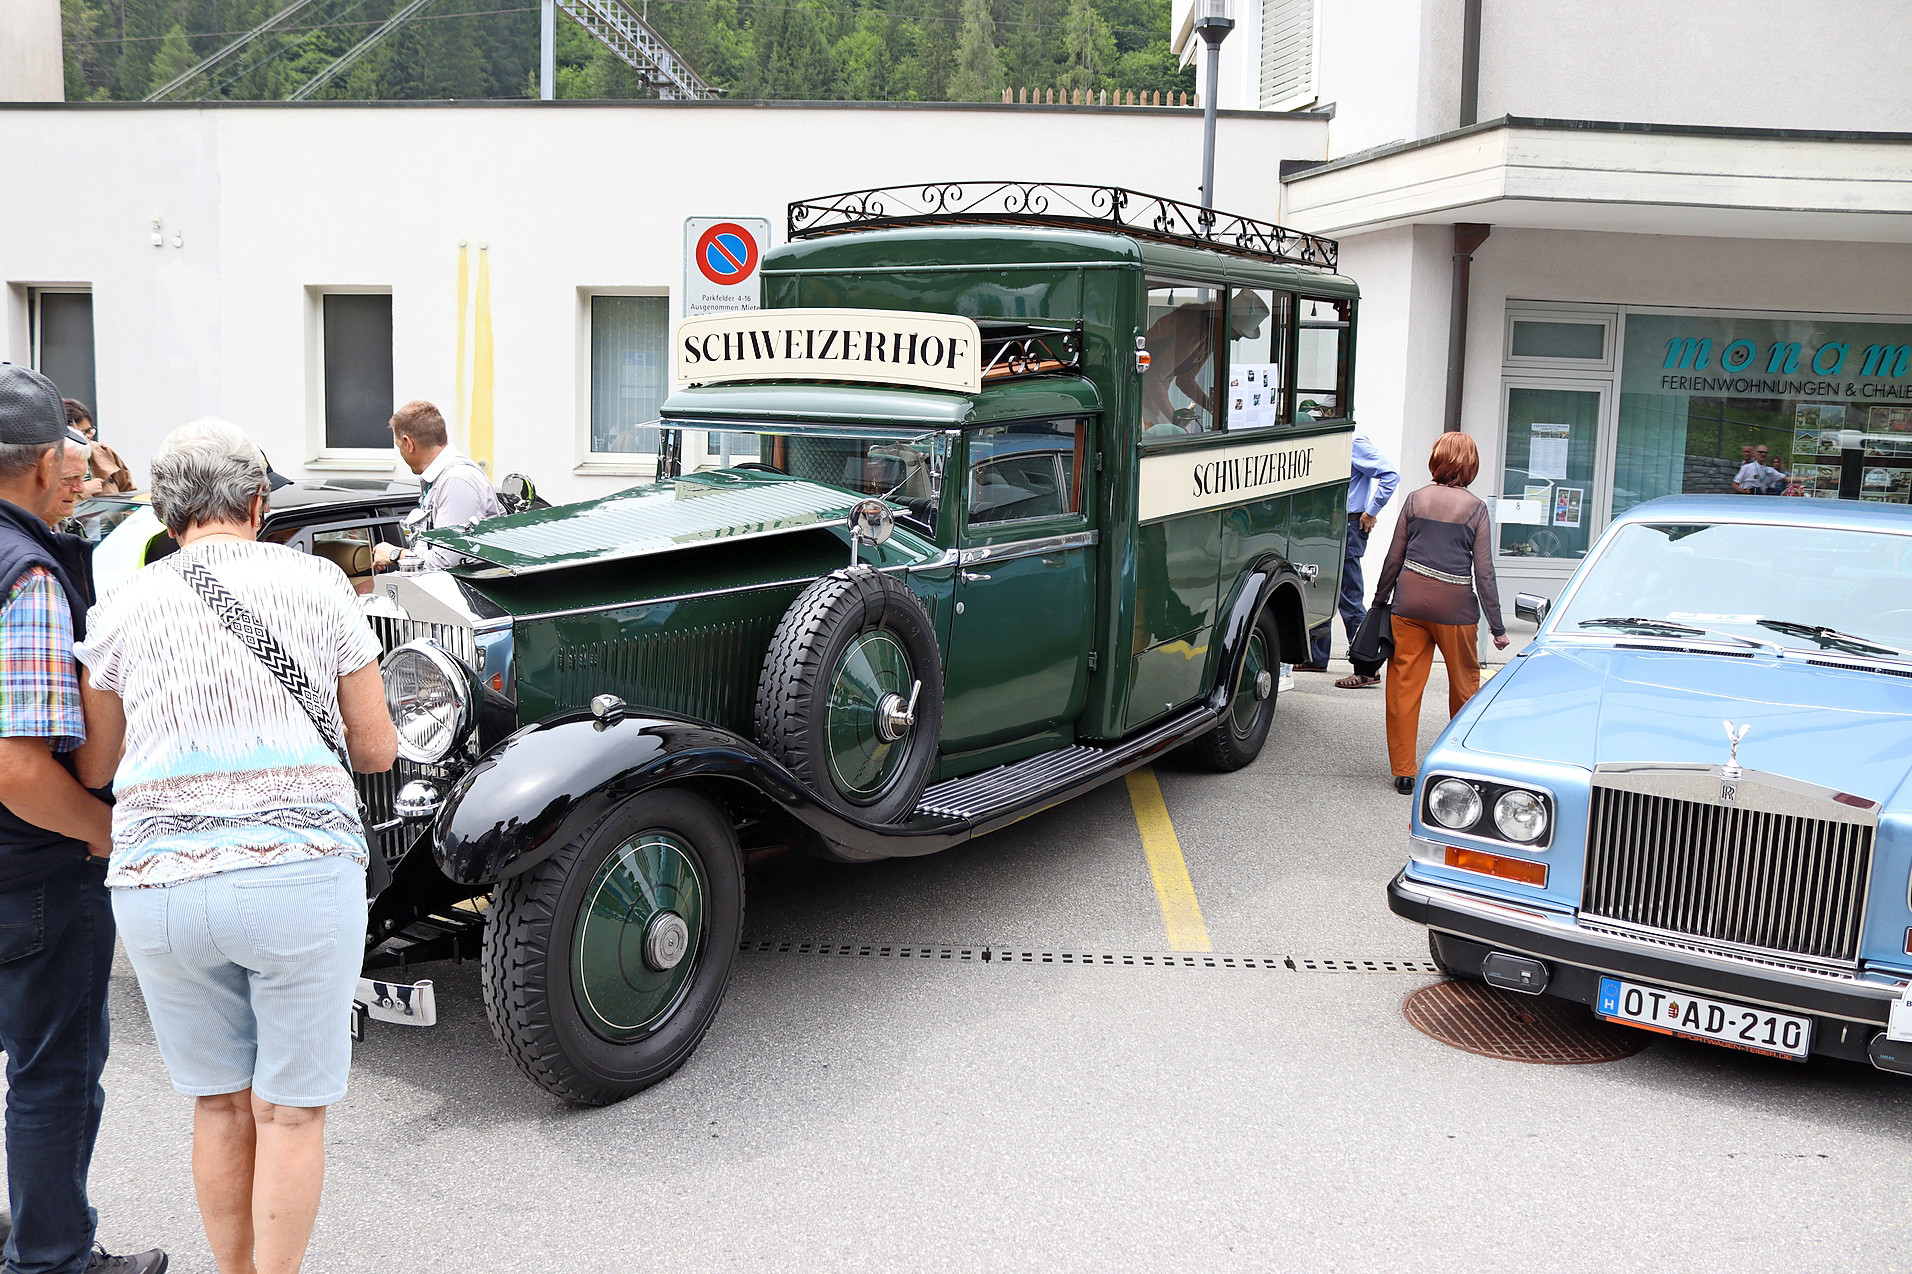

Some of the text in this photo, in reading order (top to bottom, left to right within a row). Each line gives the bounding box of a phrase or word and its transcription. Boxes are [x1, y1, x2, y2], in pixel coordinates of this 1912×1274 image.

[691, 304, 738, 312] Ausgenommen
[702, 294, 735, 302] Parkfelder
[684, 329, 969, 369] SCHWEIZERHOF
[1662, 375, 1839, 396] FERIENWOHNUNGEN
[1845, 382, 1857, 397] &
[1193, 448, 1314, 497] SCHWEIZERHOF
[1604, 998, 1615, 1010] H
[1677, 1032, 1793, 1061] SPORTWAGEN-TEIBER.DE
